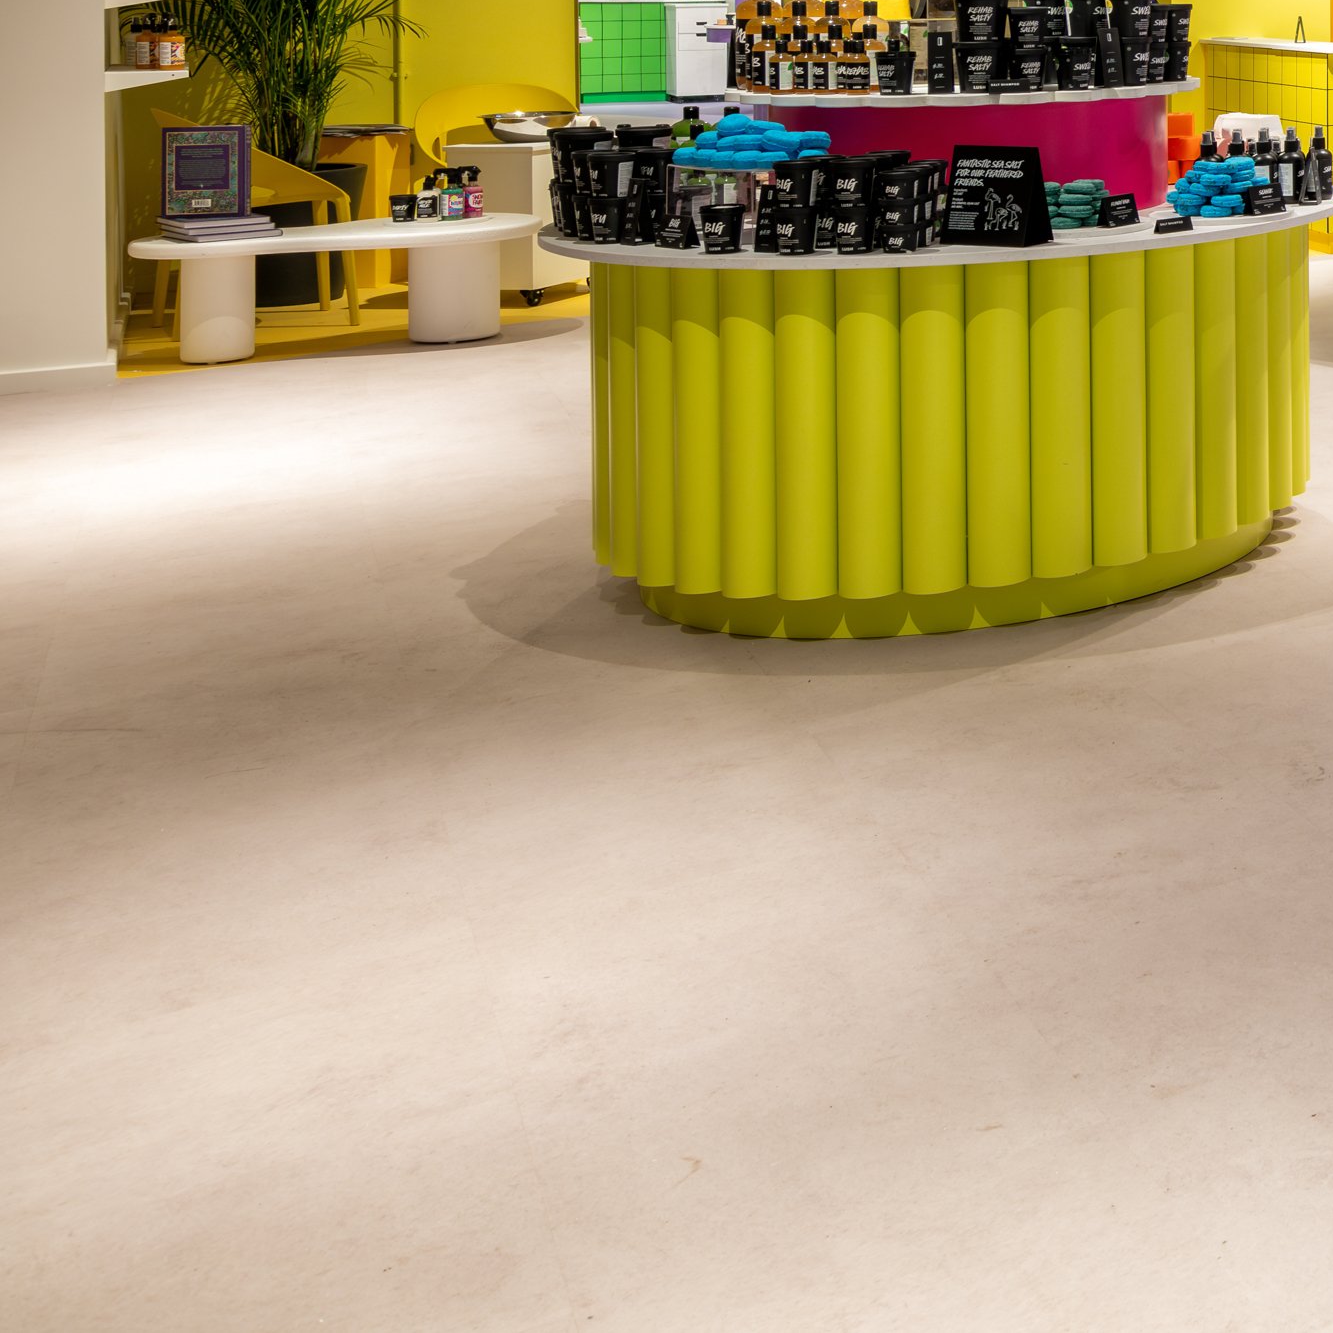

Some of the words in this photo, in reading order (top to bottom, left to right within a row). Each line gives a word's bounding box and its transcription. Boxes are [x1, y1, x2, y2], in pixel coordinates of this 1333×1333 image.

[967, 6, 994, 14] REHAB
[968, 63, 991, 71] SALTY
[957, 158, 991, 168] FANTASTIC
[991, 160, 1005, 168] SEA
[1004, 159, 1025, 169] SALT
[955, 168, 970, 177] FOR
[970, 169, 985, 177] OUR
[985, 169, 1024, 178] FEATHERED
[776, 178, 794, 192] BIG
[836, 178, 858, 192] BIG
[885, 185, 900, 195] BIG
[885, 211, 901, 221] BIG
[704, 222, 725, 235] BIG
[776, 223, 795, 237] BIG
[837, 222, 858, 235] BIG
[888, 237, 904, 246] BIG
